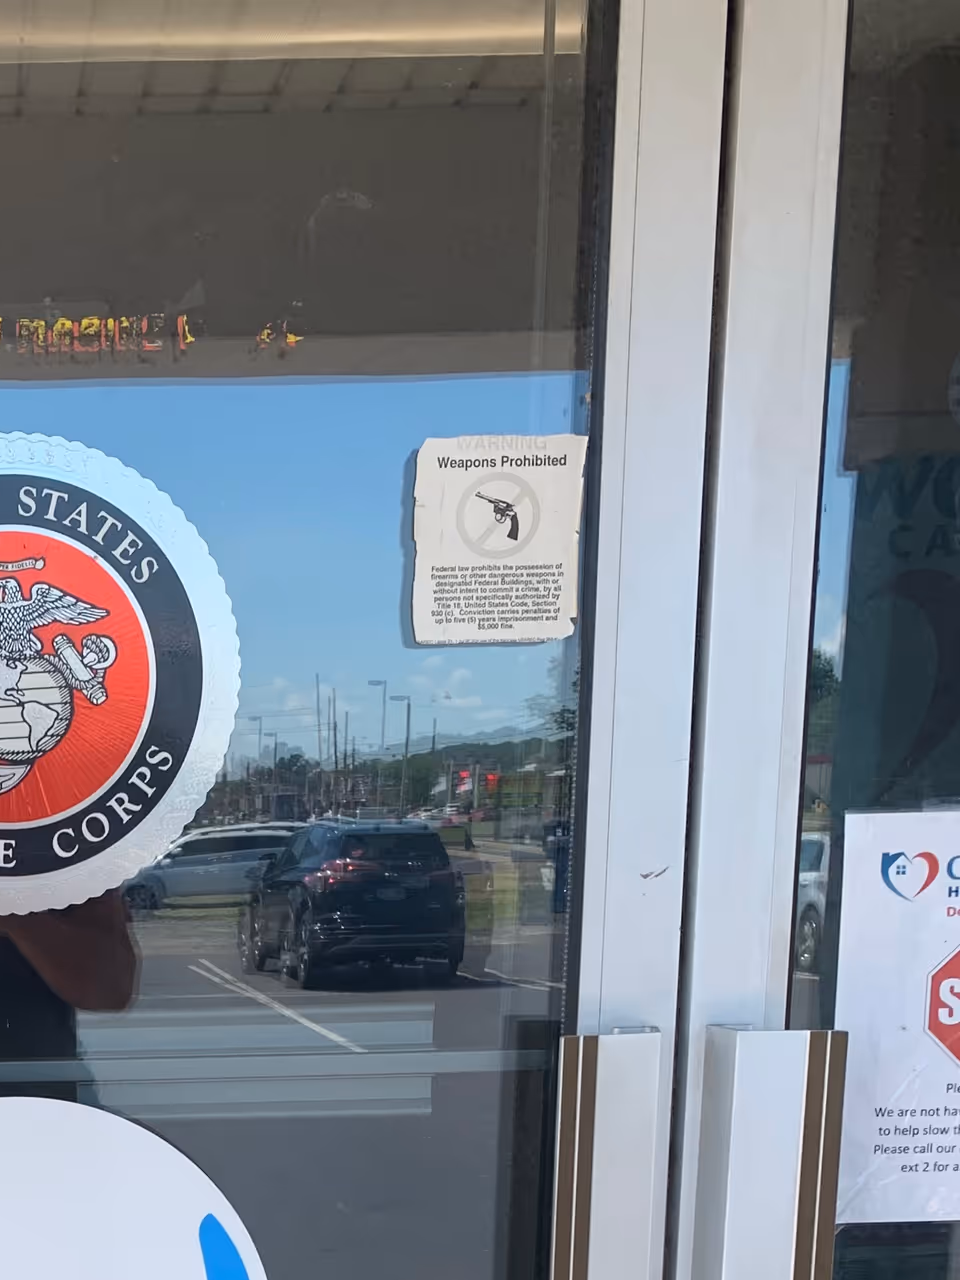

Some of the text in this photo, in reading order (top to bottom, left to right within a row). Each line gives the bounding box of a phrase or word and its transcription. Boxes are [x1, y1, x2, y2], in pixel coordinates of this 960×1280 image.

[437, 454, 567, 471] Weapons Prohibited
[18, 486, 160, 585] STATES
[11, 560, 34, 569] FIDELIS
[471, 564, 500, 572] prohibits
[488, 572, 524, 580] dangerous
[435, 580, 472, 588] designated
[498, 615, 543, 623] imprisonment
[51, 744, 175, 860] CORPS
[874, 1106, 894, 1118] We
[897, 1108, 917, 1118] are
[920, 1107, 941, 1117] not
[878, 1127, 891, 1136] to
[894, 1124, 920, 1138] help
[922, 1124, 950, 1136] slow
[873, 1142, 957, 1155] Please call our
[900, 1163, 919, 1173] ext
[922, 1161, 930, 1173] 2
[933, 1160, 949, 1172] for
